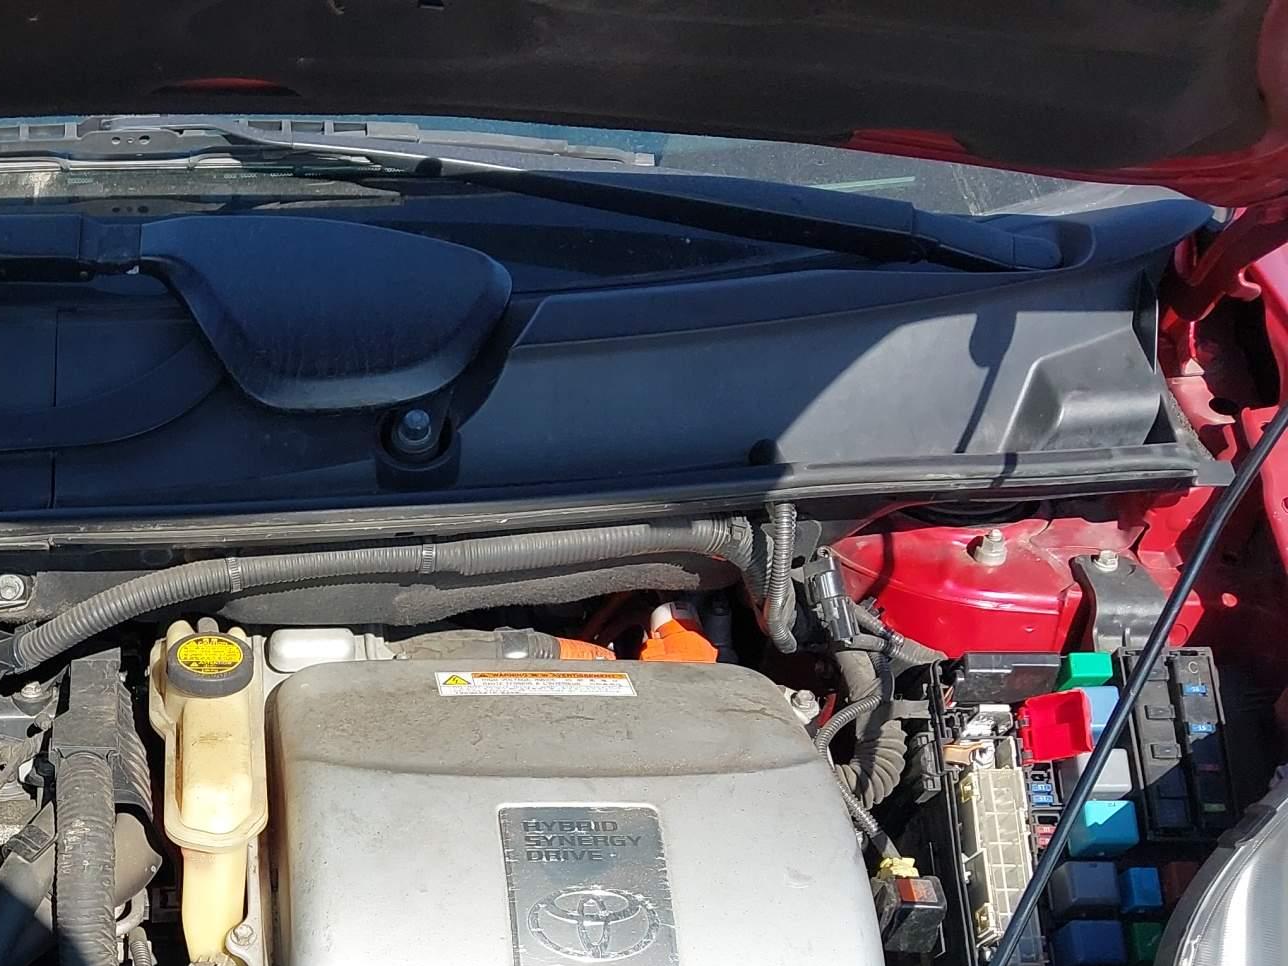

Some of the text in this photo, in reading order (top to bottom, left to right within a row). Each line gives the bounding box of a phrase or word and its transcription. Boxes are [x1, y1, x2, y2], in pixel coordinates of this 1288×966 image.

[522, 820, 618, 832] HYBRID
[525, 835, 642, 847] SYNERGY
[526, 850, 604, 862] DRIVE
